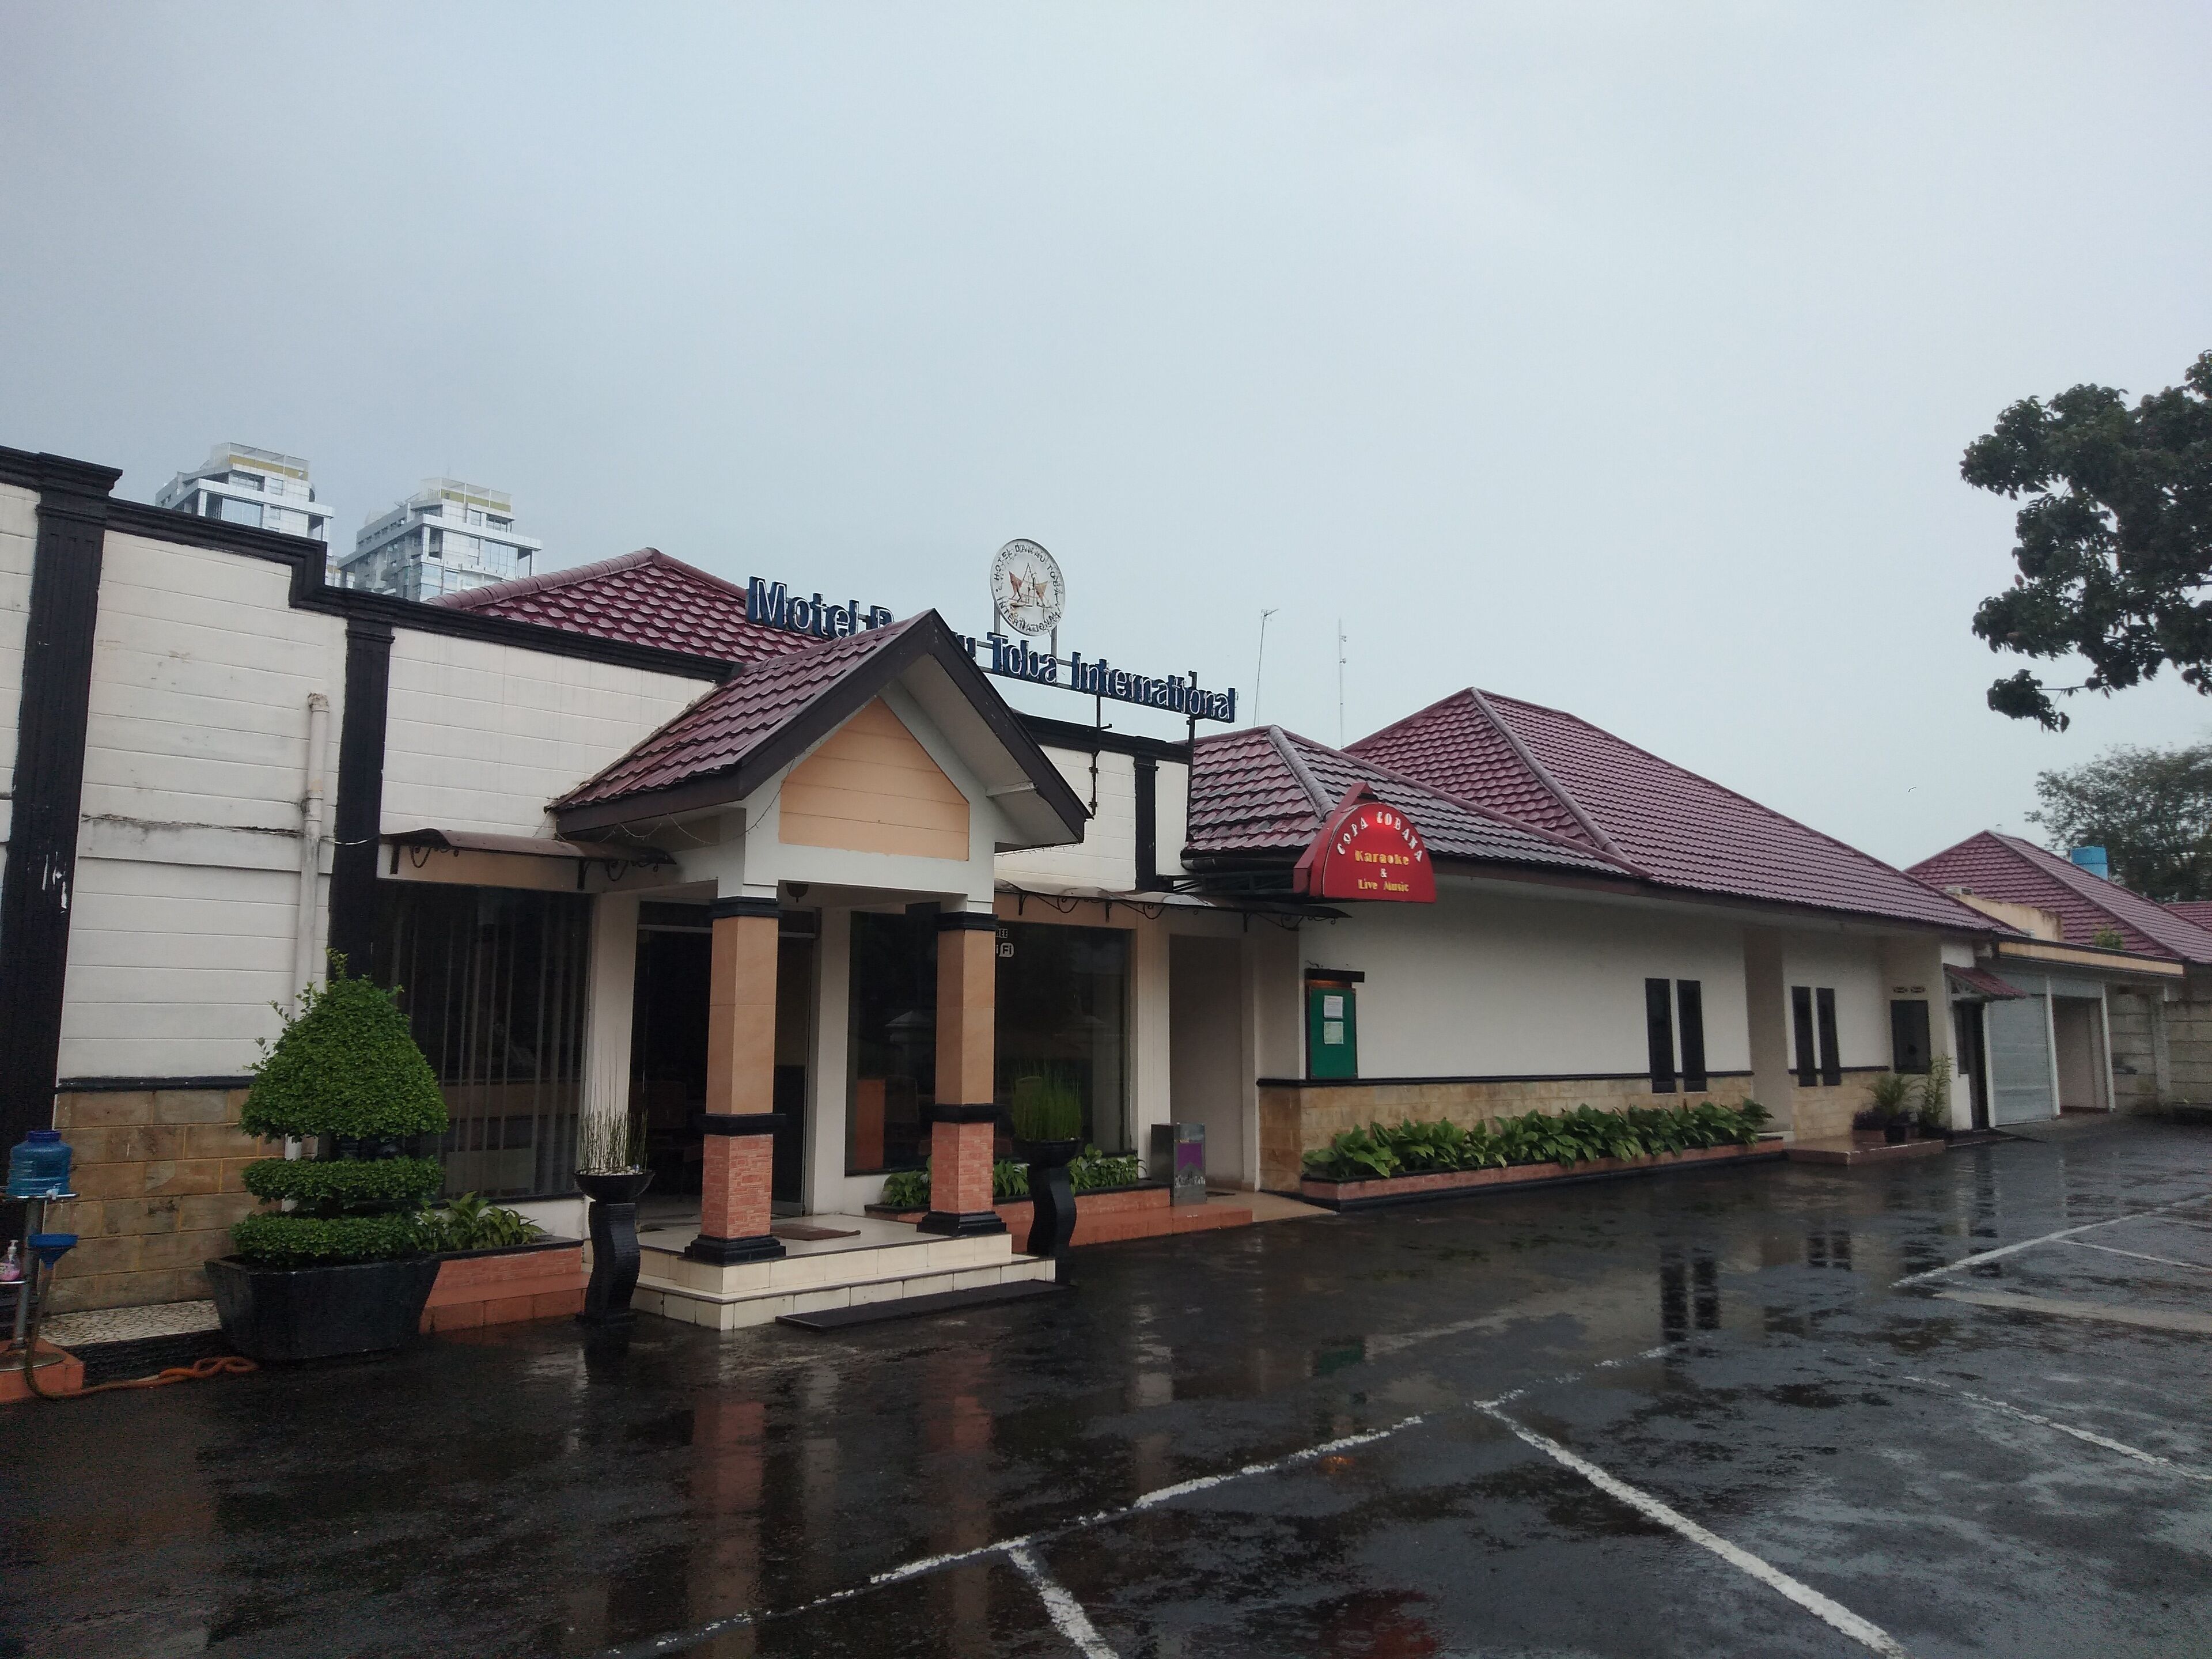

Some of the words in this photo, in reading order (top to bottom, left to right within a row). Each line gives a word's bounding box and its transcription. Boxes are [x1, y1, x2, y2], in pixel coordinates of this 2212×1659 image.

[747, 576, 859, 639] Motel
[987, 632, 1058, 683] Toba
[1071, 652, 1237, 724] International
[1337, 817, 1368, 855] COPA
[1355, 850, 1410, 865] Karaoke
[1380, 868, 1387, 878] &
[1358, 879, 1378, 891] Live
[1384, 880, 1409, 892] Music
[996, 929, 1008, 938] REE
